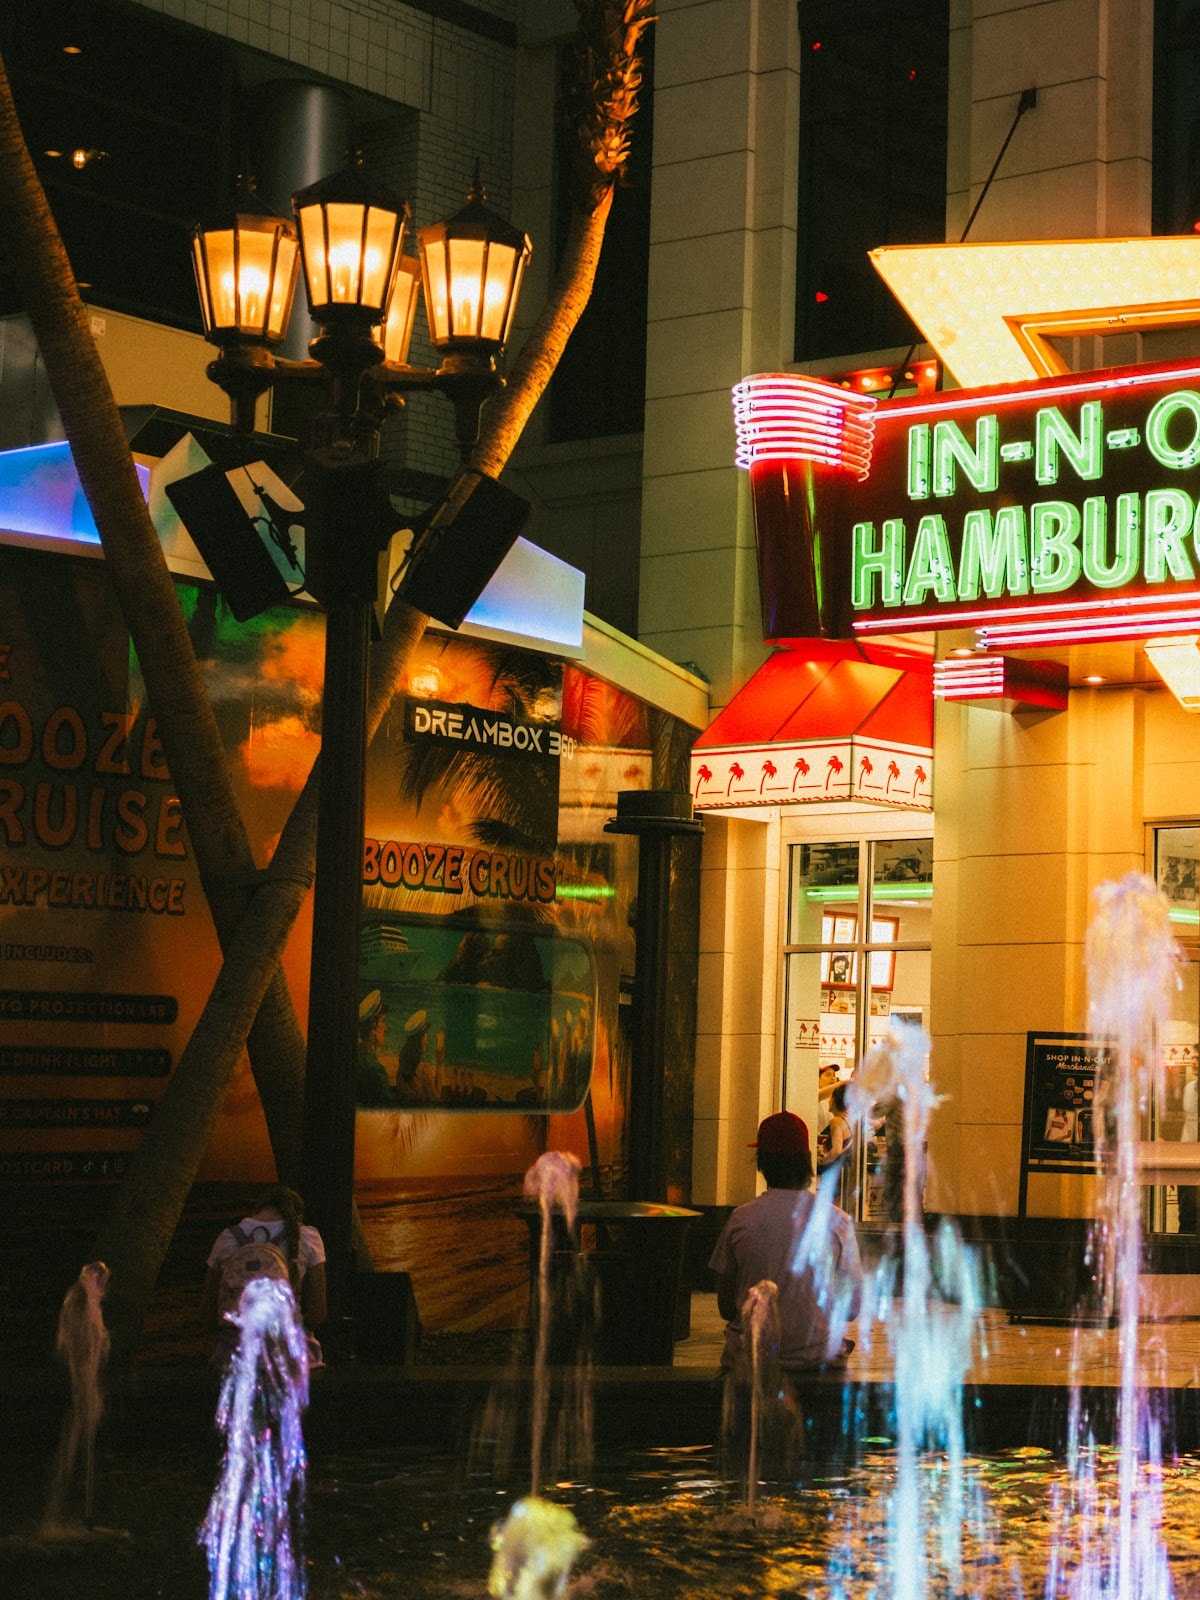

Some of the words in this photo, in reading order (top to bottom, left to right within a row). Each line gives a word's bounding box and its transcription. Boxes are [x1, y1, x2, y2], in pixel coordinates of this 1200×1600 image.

[414, 707, 543, 754] DREAMBOX
[362, 838, 464, 895] BOOZE
[1045, 1054, 1070, 1062] SHOP
